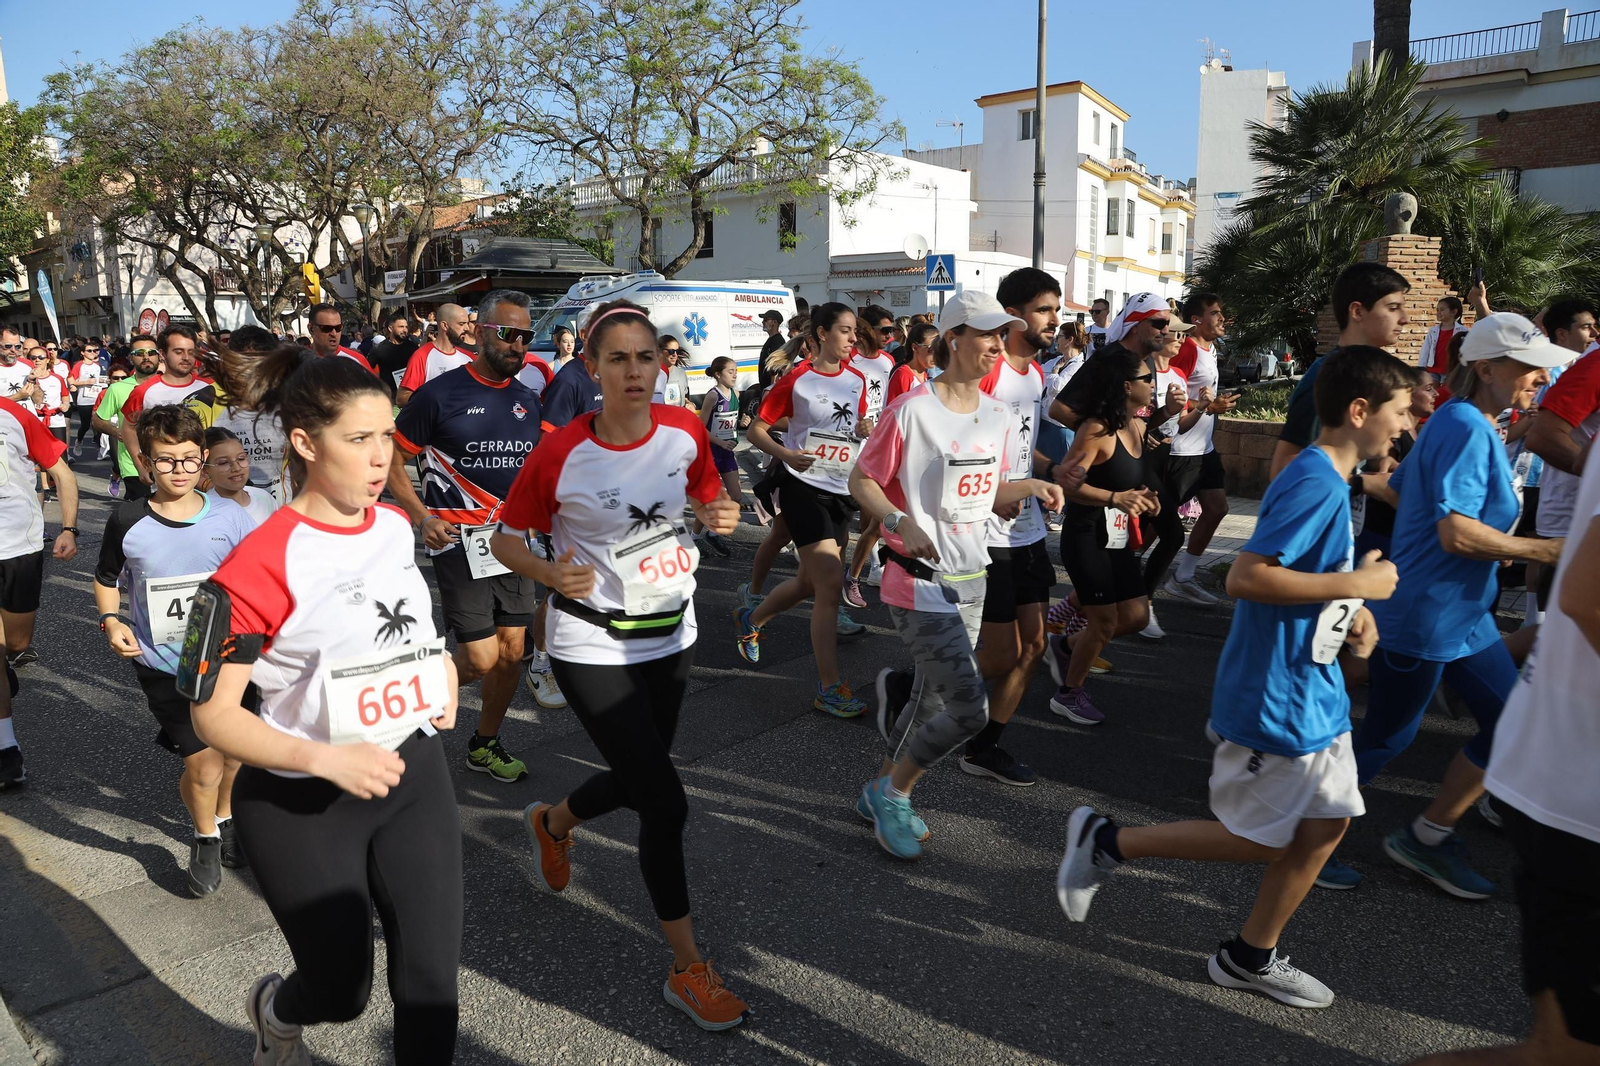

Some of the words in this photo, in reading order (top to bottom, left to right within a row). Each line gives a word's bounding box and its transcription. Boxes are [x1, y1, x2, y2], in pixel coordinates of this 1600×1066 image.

[734, 294, 784, 305] AMBULANCIA
[718, 420, 734, 430] 781
[466, 440, 533, 453] CERRADO
[814, 444, 850, 463] 476
[460, 452, 525, 468] CALDERÓ
[957, 472, 993, 498] 635
[639, 545, 692, 584] 660
[357, 674, 431, 727] 661
